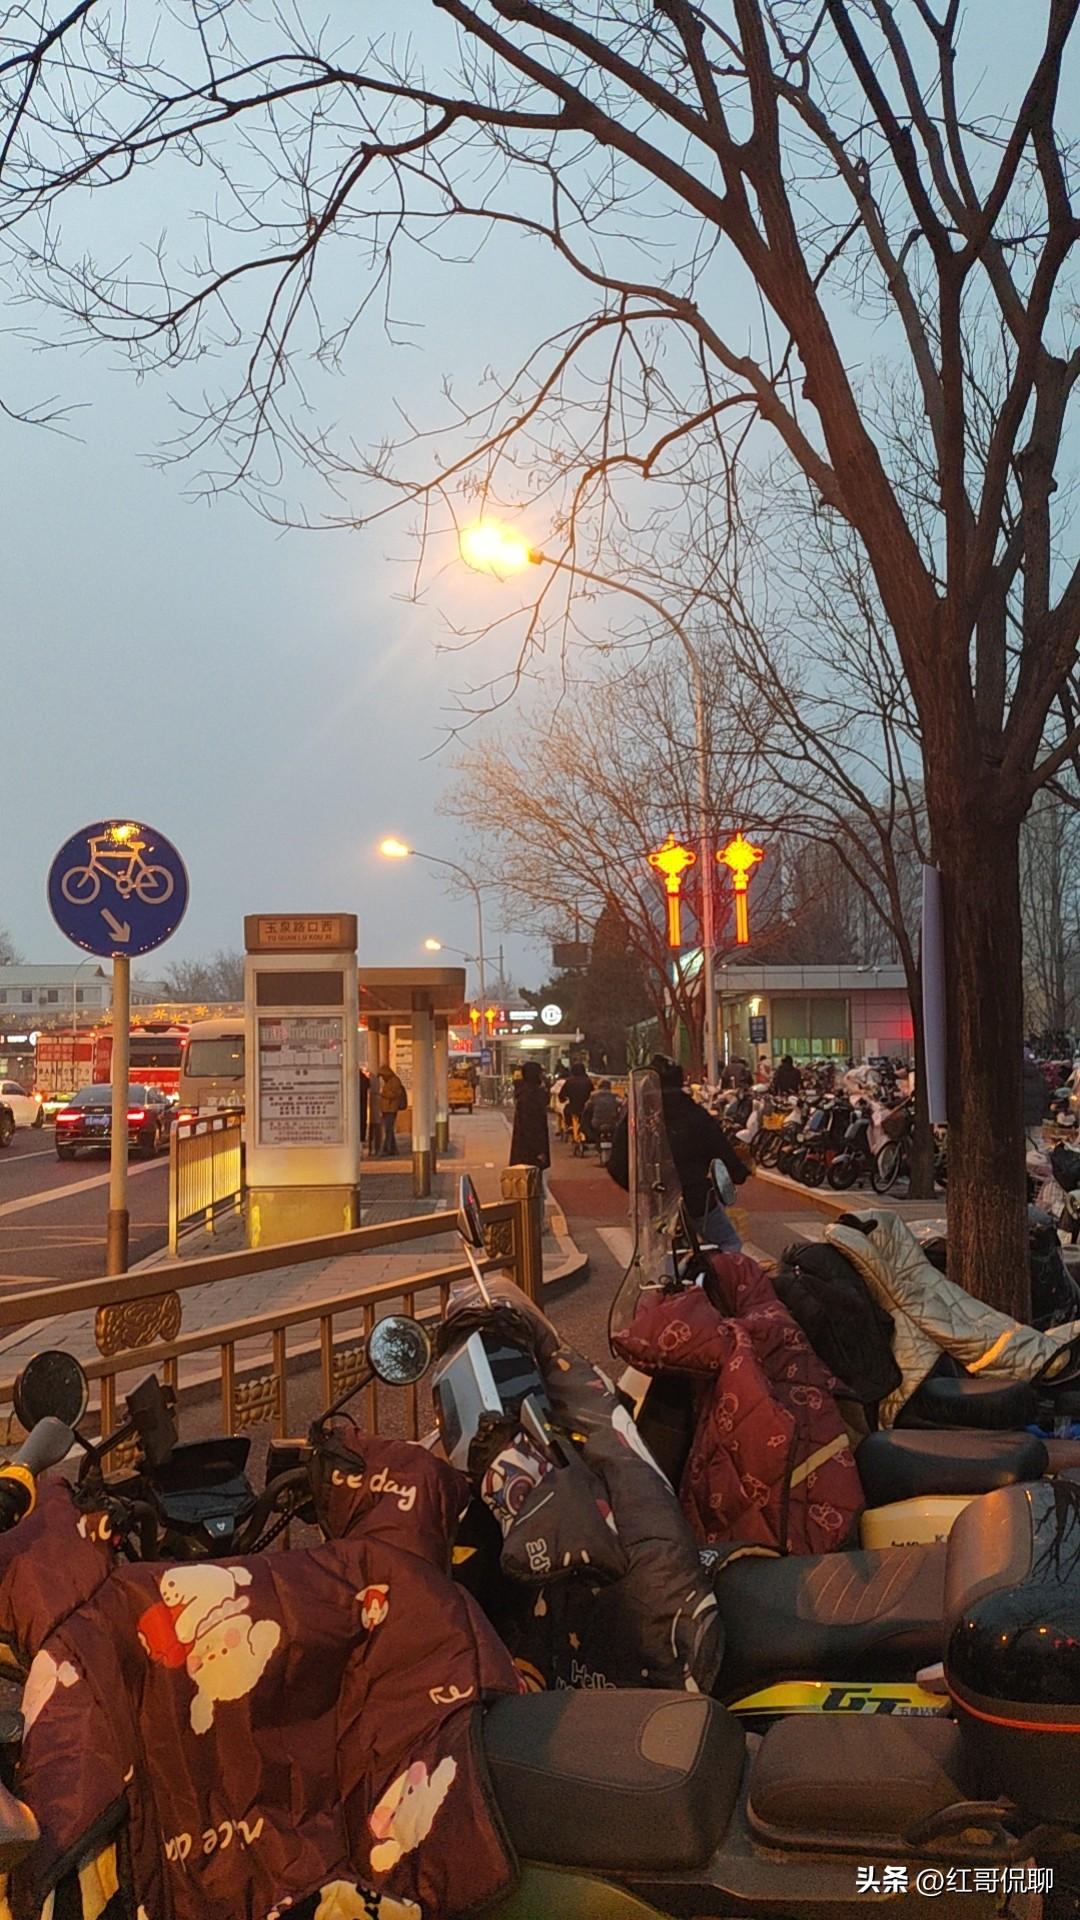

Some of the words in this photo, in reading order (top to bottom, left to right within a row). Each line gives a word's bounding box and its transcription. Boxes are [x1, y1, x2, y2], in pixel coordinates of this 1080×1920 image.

[265, 920, 333, 934] 玉泉路口西
[369, 1467, 417, 1512] day
[822, 1687, 912, 1715] GT
